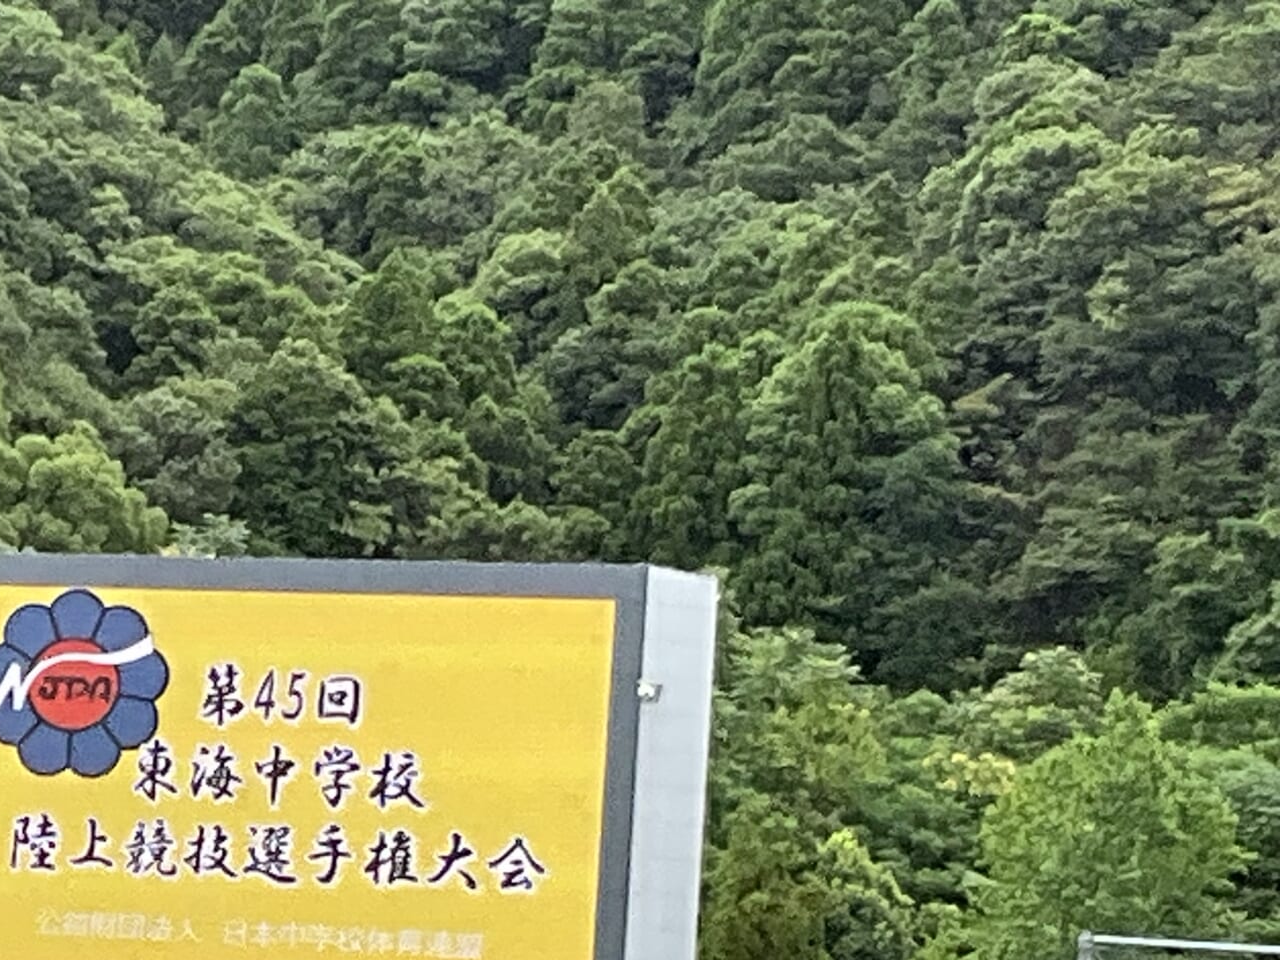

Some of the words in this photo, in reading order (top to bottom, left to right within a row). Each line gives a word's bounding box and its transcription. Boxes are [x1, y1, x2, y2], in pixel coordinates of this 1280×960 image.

[202, 663, 363, 726] 第45回
[132, 739, 425, 808] 東海中学校
[9, 813, 546, 890] 陸上競技選手権大会
